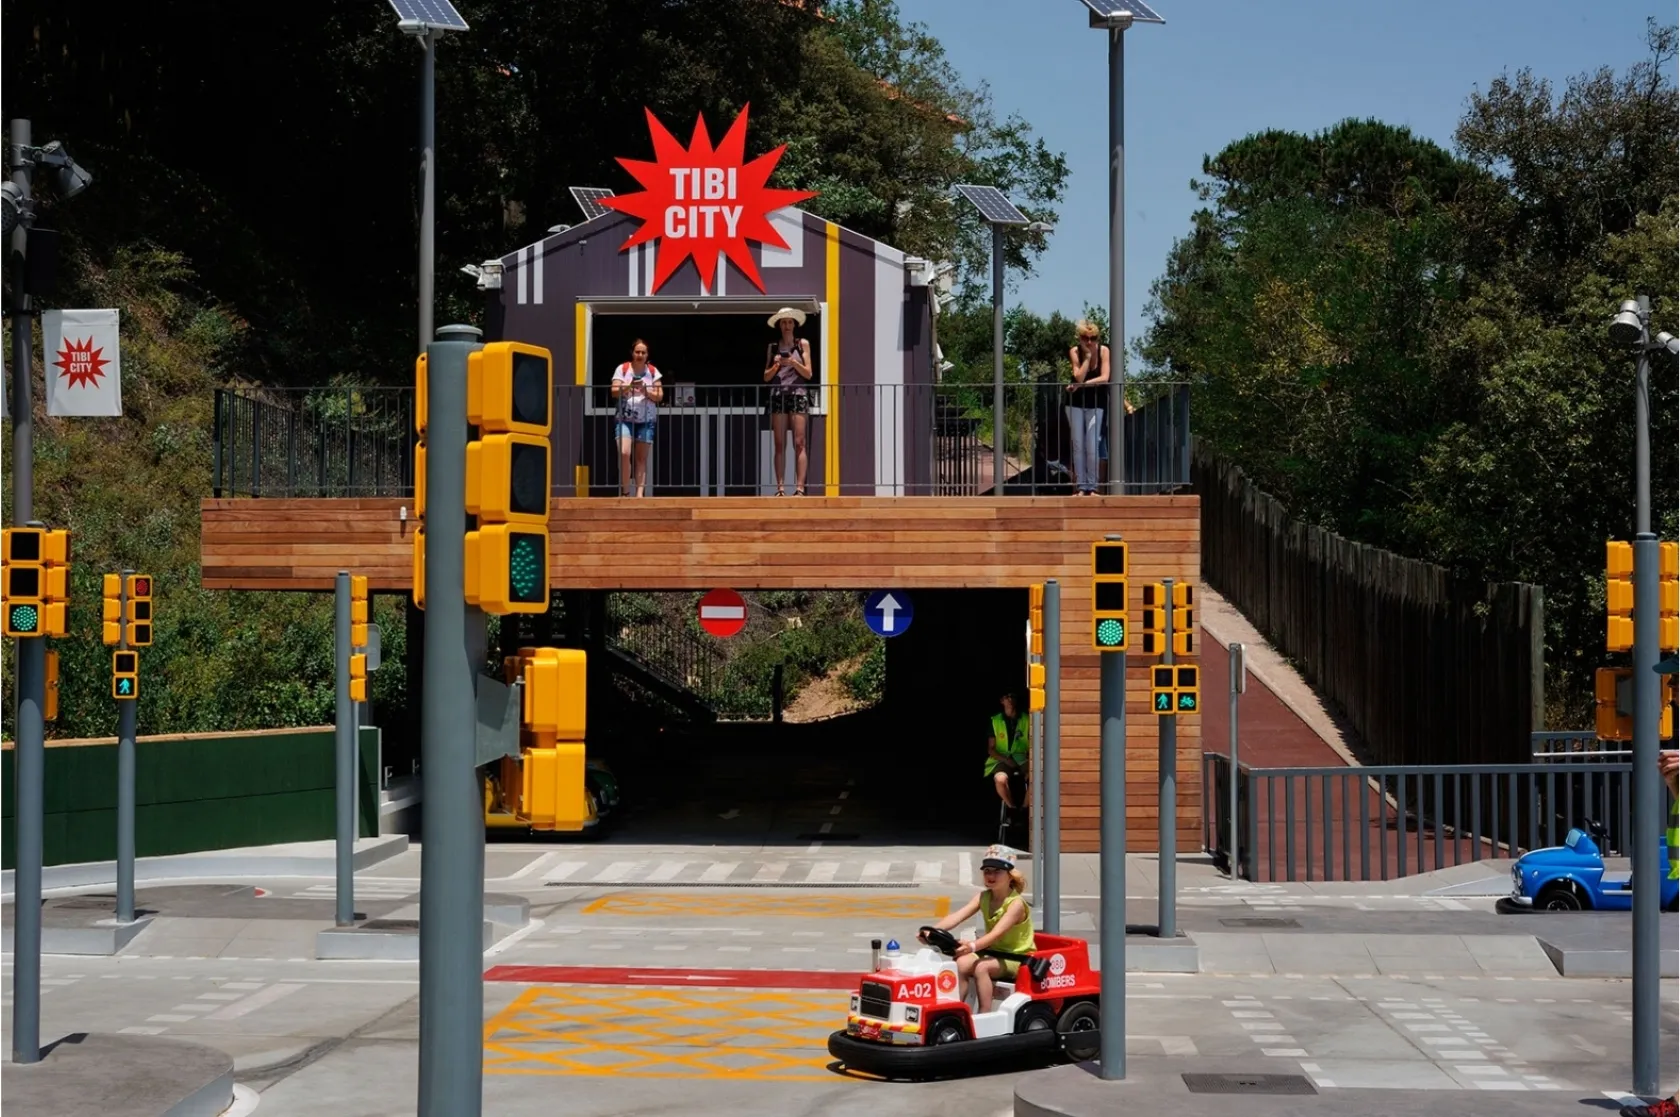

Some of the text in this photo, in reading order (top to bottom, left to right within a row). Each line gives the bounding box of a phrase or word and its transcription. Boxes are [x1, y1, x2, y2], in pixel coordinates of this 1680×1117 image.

[669, 167, 737, 200] TIBI
[664, 205, 744, 238] CITY
[70, 351, 91, 362] TIBI
[69, 362, 93, 373] CITY
[897, 982, 932, 1000] A-02
